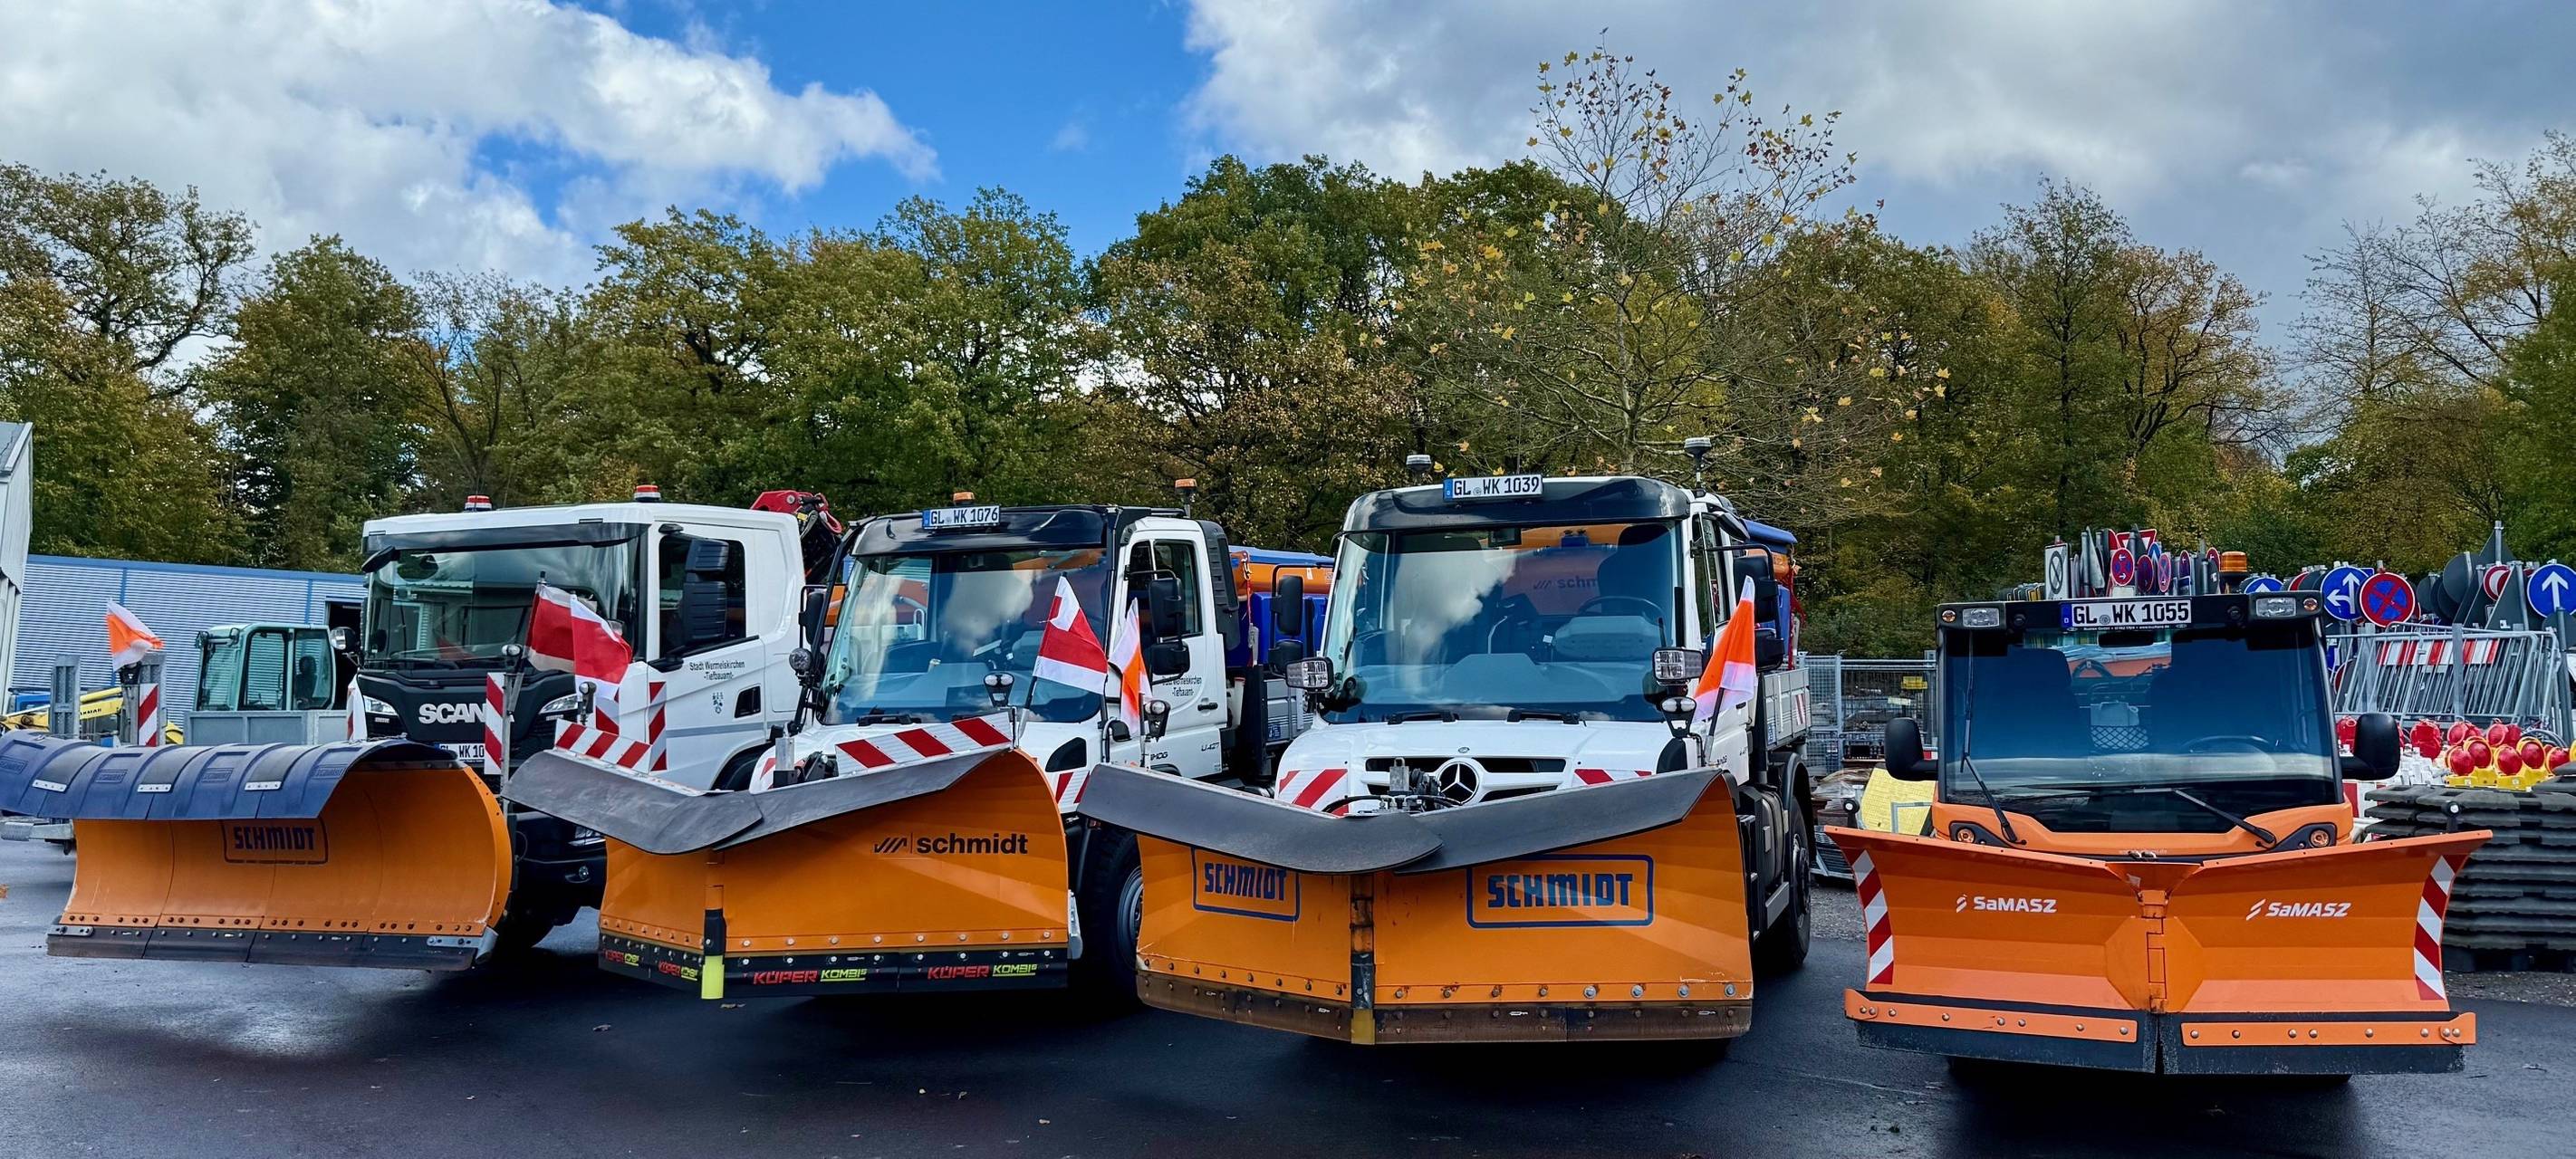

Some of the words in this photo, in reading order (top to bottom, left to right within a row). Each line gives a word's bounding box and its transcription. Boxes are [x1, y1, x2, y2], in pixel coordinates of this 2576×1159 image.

[1454, 481, 1471, 495] GL
[1483, 478, 1500, 494] WK
[1504, 476, 1540, 493] 1039
[931, 511, 945, 524] GL
[954, 509, 967, 523] WK
[970, 507, 998, 522] 1076
[1557, 576, 1597, 589] schm
[2073, 605, 2098, 625] GL
[2112, 604, 2136, 624] WK
[2141, 602, 2189, 623] 1055
[418, 703, 514, 724] SCAN
[458, 745, 471, 758] WK
[473, 744, 485, 758] 10
[233, 826, 315, 850] SCHMIDT
[916, 833, 1029, 854] schmidt
[1205, 863, 1286, 901] SCHMIDT
[1487, 874, 1633, 907] SCHMIDT
[1973, 896, 2057, 914] SaMASZ
[2265, 902, 2351, 917] SaMASZ
[753, 970, 818, 984] KÜPER
[928, 965, 990, 980] KÜPER
